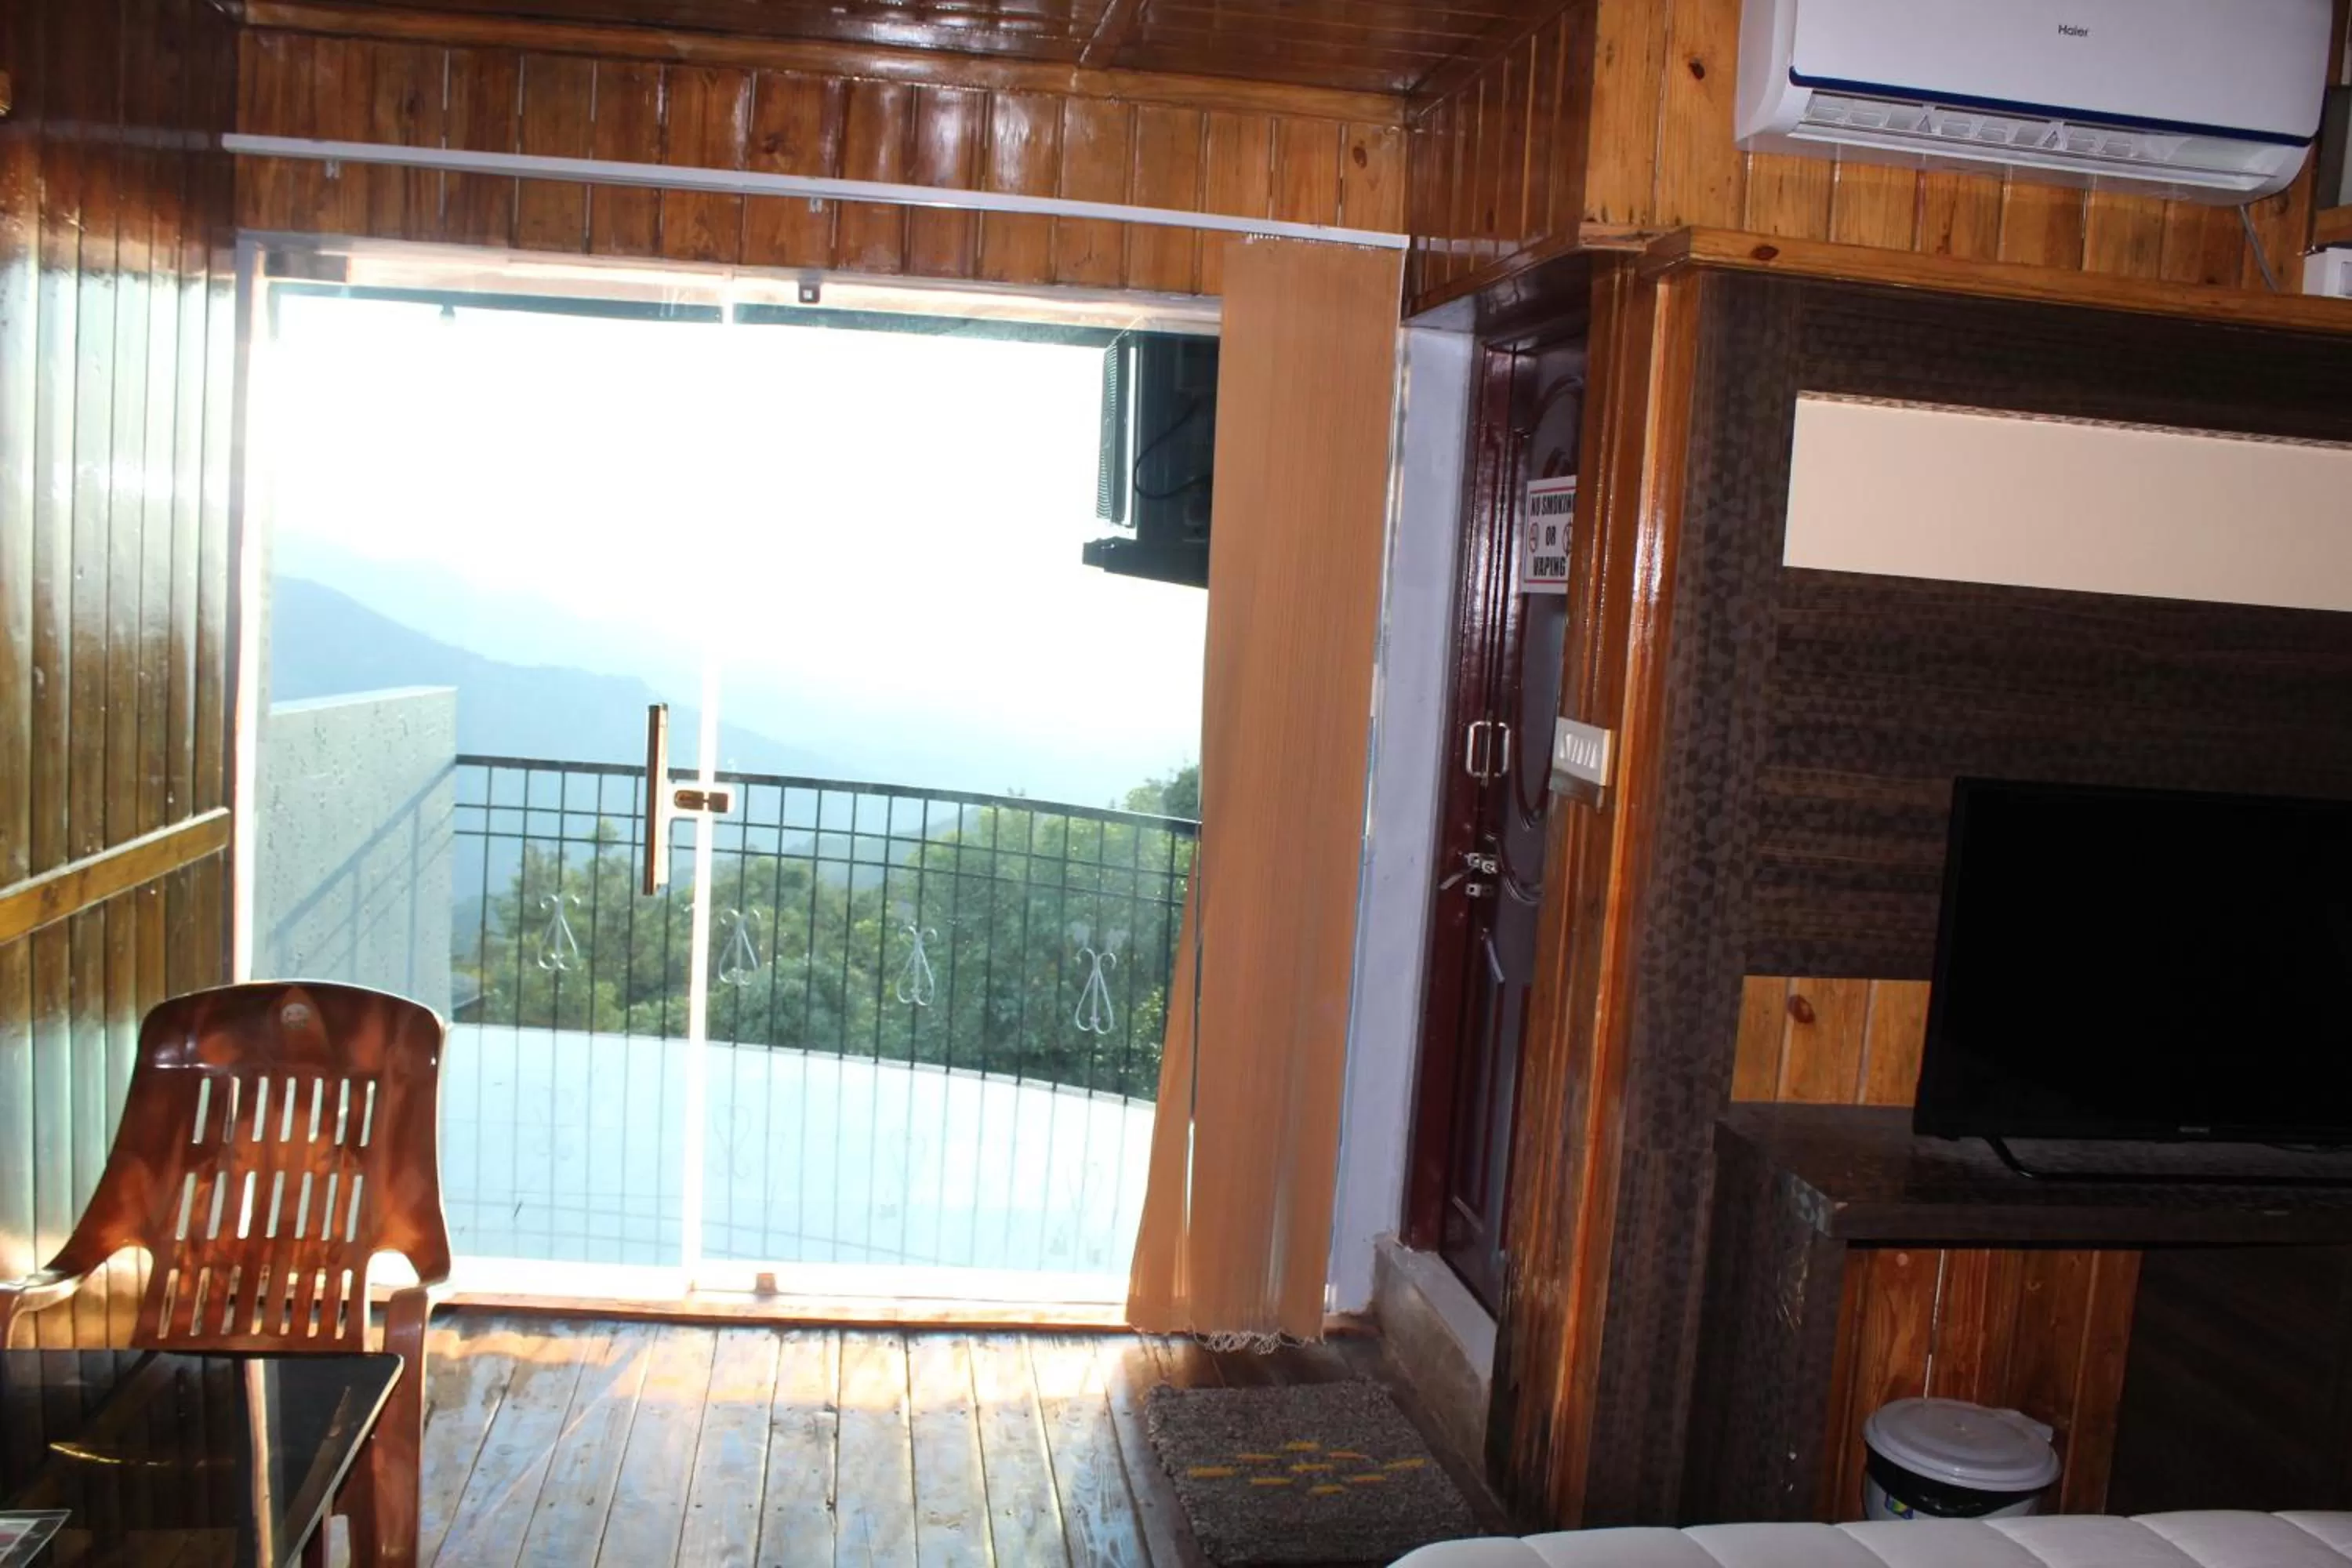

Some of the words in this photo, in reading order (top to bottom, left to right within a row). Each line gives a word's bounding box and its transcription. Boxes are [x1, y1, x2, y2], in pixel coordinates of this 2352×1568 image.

[2057, 24, 2088, 37] Haier
[1530, 496, 1540, 517] NO
[1545, 525, 1556, 546] OR
[1533, 556, 1566, 578] VAPING
